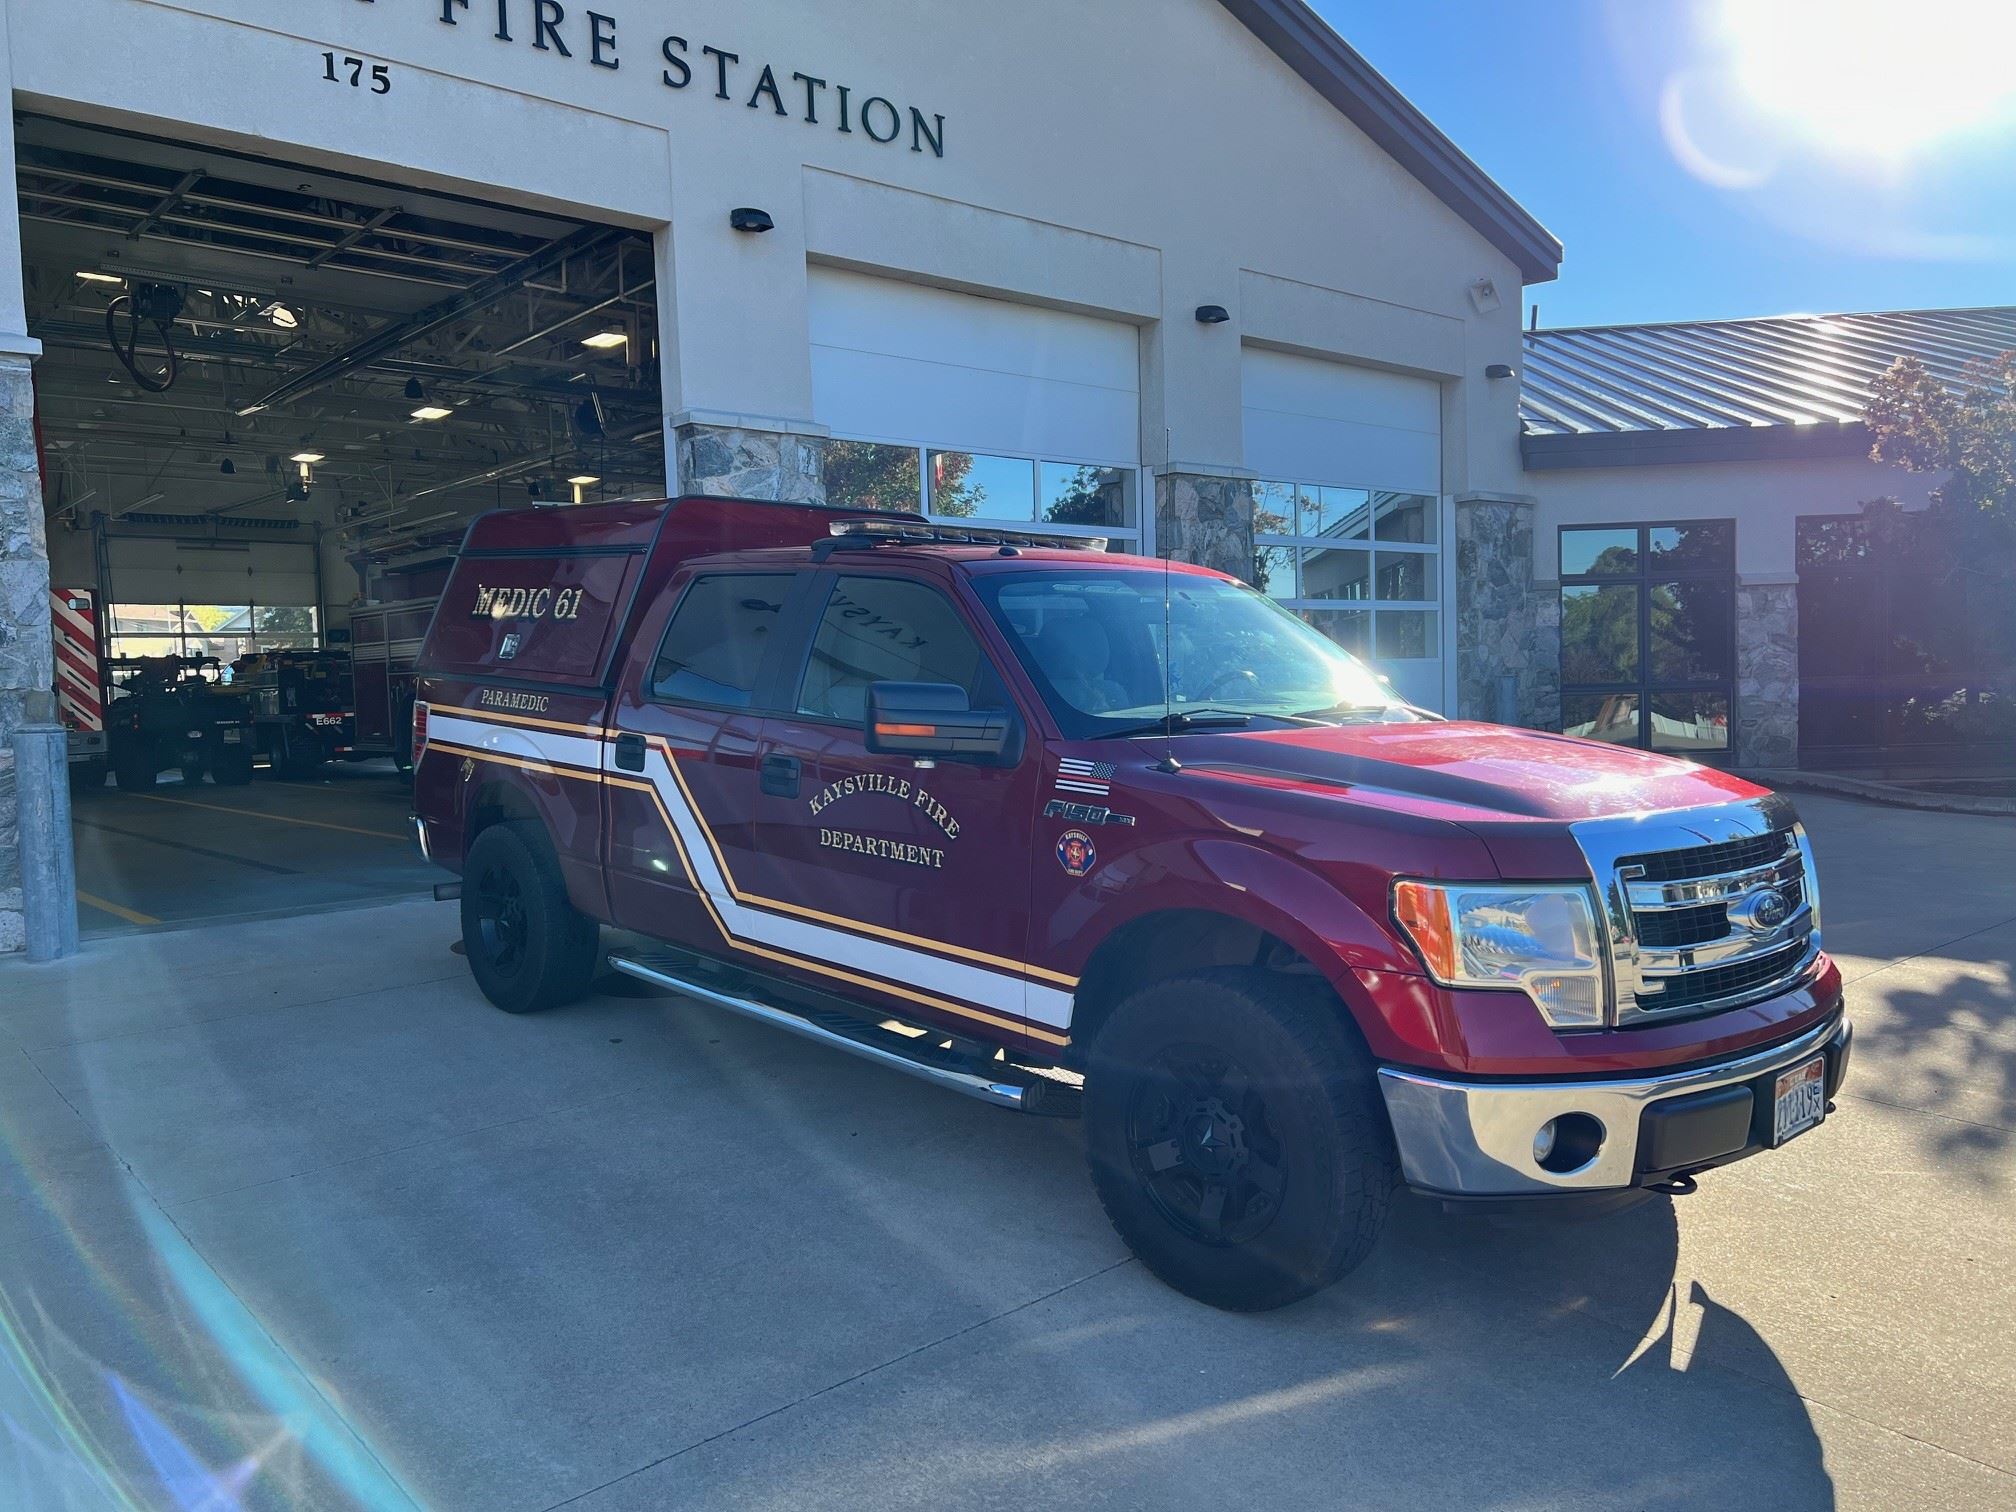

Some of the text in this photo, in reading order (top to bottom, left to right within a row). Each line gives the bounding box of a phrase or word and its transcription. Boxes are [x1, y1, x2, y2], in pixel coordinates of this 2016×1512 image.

[322, 51, 392, 95] 175
[661, 35, 946, 158] STATION
[472, 587, 583, 619] MEDIC 61
[316, 716, 342, 726] E662
[481, 689, 549, 713] PARAMEDIC
[808, 773, 960, 840] KAYSVILLE FIRE
[820, 828, 945, 868] DEPARTMENT
